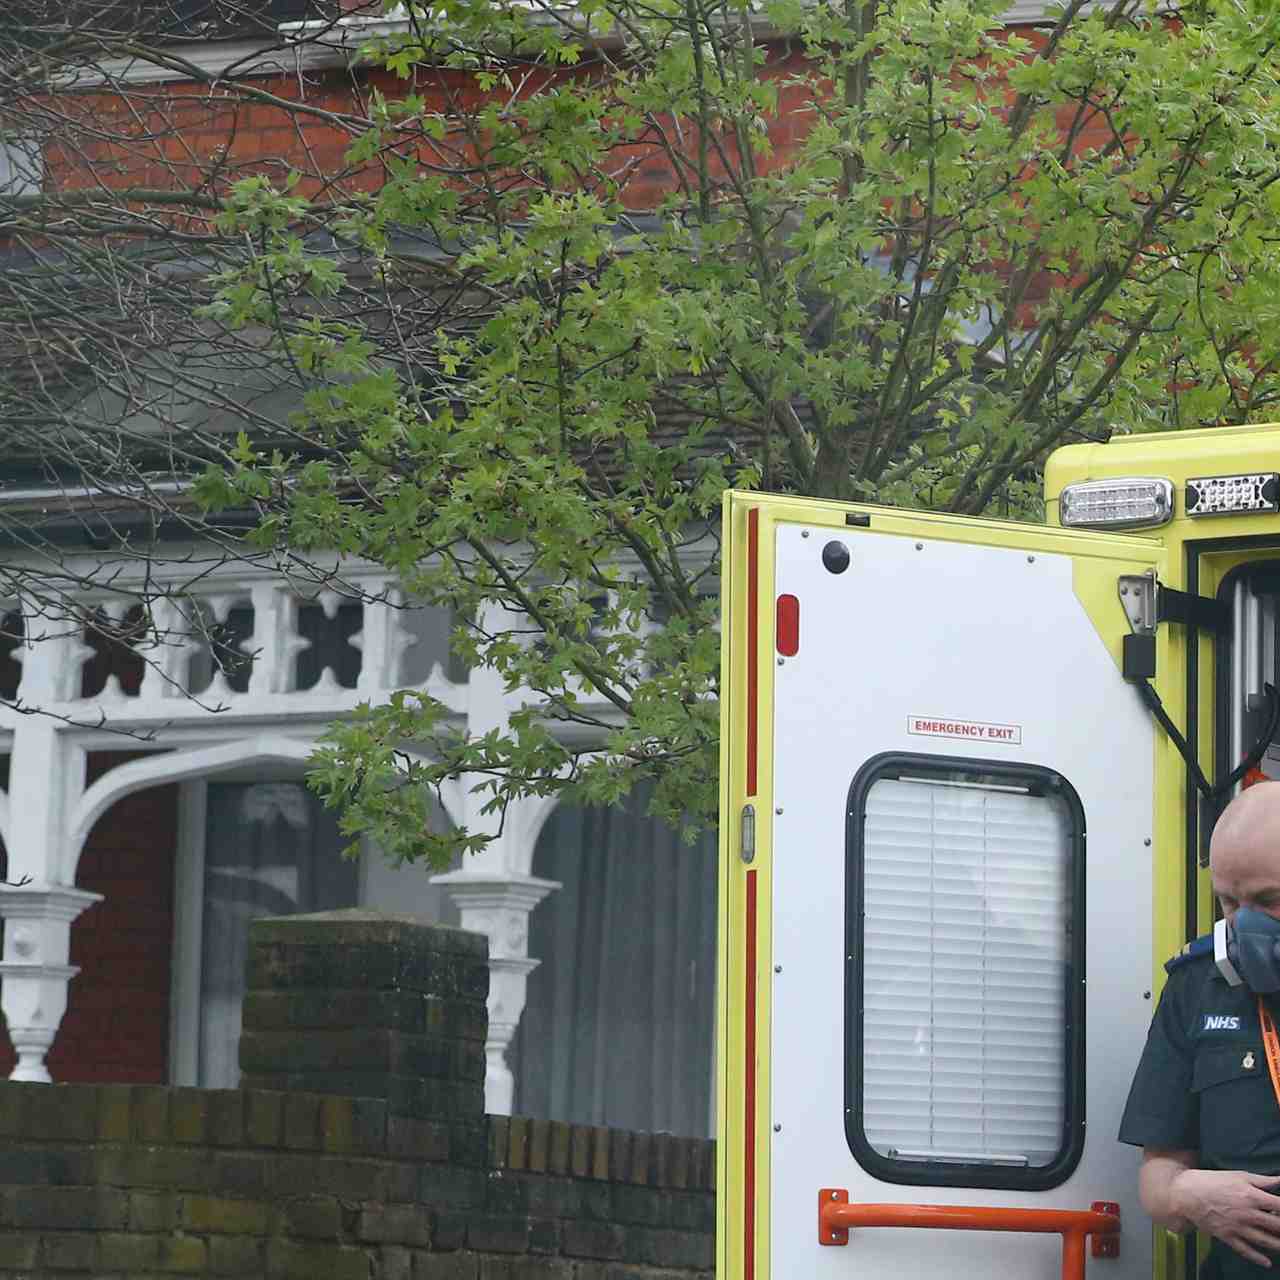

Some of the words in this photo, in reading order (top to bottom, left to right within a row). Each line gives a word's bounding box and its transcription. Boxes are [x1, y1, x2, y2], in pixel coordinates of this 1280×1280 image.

[915, 720, 985, 736] EMERGENCY
[988, 728, 1014, 739] EXIT
[1204, 1016, 1240, 1030] NHS
